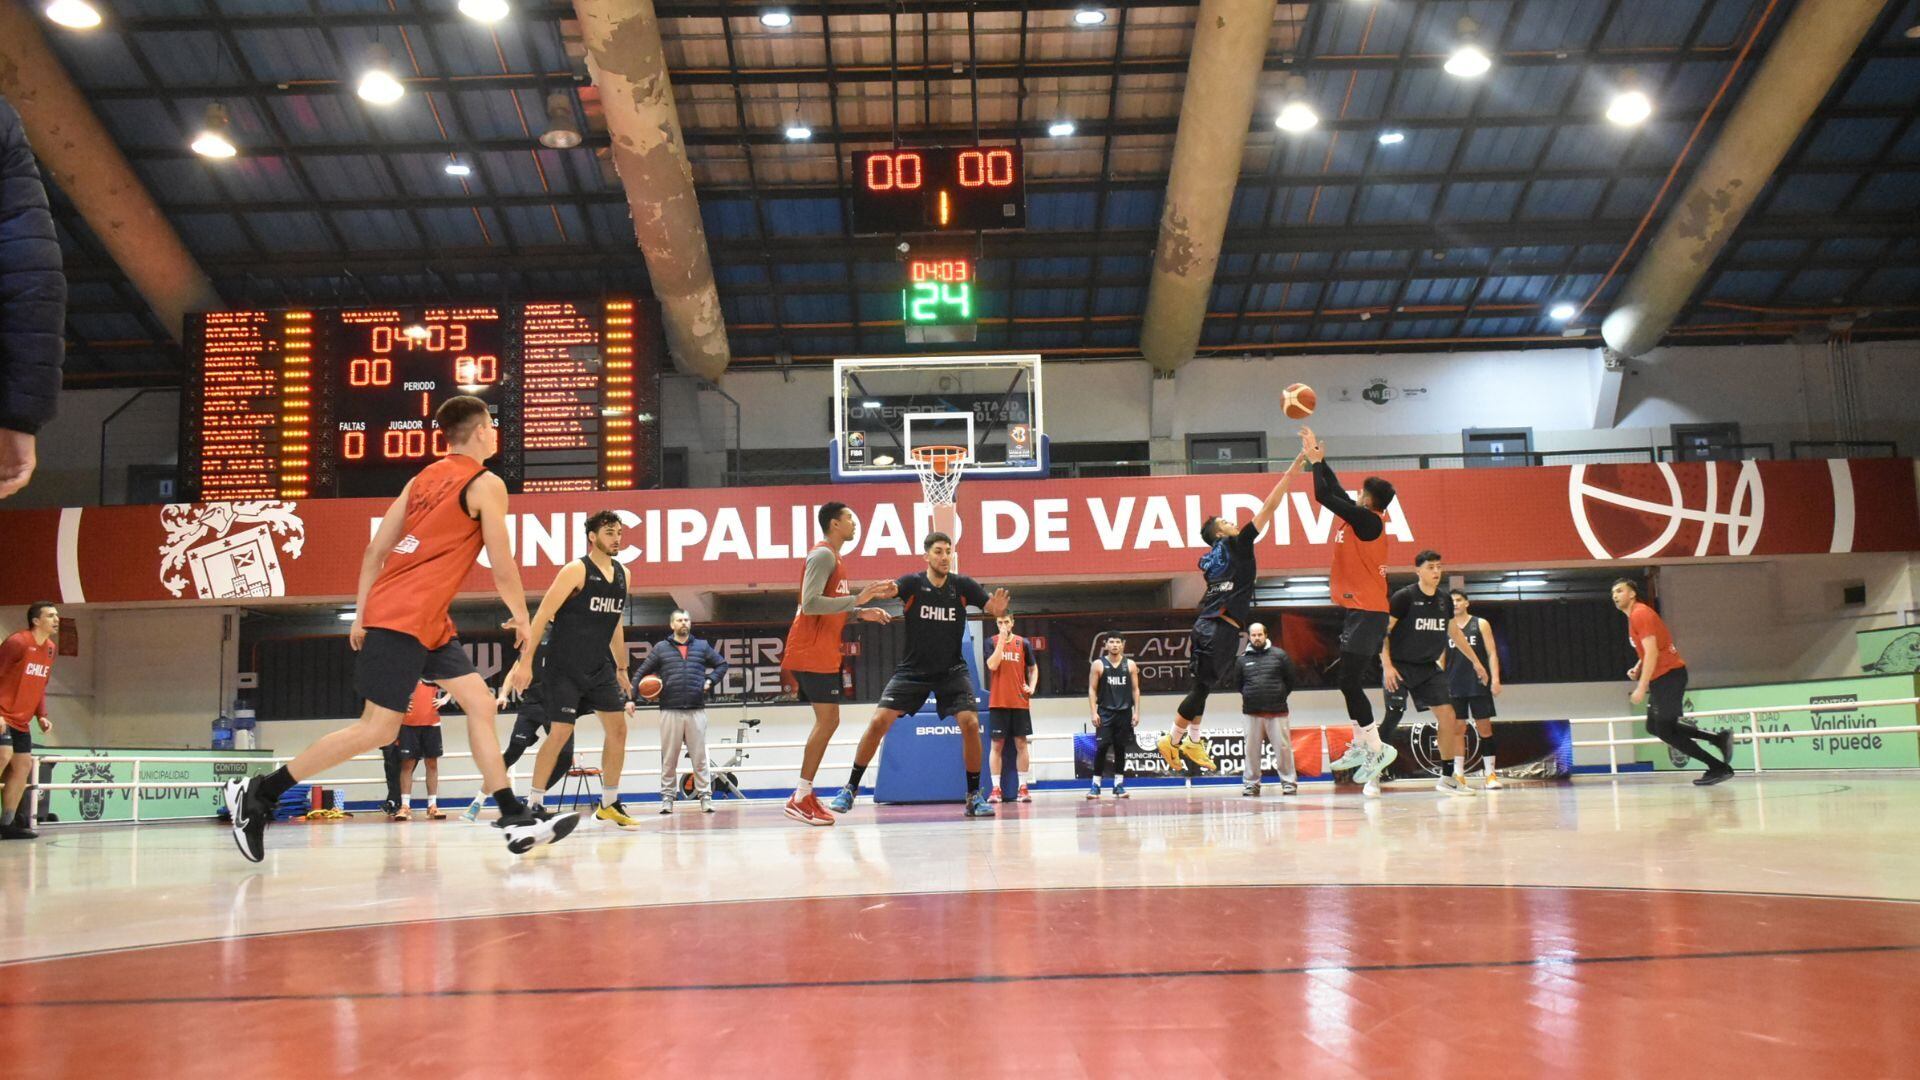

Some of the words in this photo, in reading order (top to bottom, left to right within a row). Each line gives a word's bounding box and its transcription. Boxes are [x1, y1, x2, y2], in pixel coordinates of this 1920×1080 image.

[867, 154, 921, 190] 00
[958, 150, 1012, 187] 00
[912, 261, 967, 282] 04:03
[911, 281, 970, 321] 24
[350, 358, 392, 386] 00
[403, 381, 436, 391] PERIODO
[338, 421, 366, 431] FALTAS
[388, 420, 423, 430] JUGADOR
[344, 432, 365, 459] 0
[384, 430, 425, 458] 00
[981, 499, 1071, 555] DE
[1086, 490, 1415, 551] VALDIVA
[590, 596, 623, 613] CHILE
[920, 605, 956, 621] CHILE
[1415, 618, 1446, 631] CHILE
[1001, 651, 1020, 662] HILE
[26, 662, 50, 678] CHILE
[916, 725, 985, 736] BRONSN
[1811, 713, 1877, 731] Valdivia
[1829, 732, 1883, 755] puede
[215, 763, 247, 772] CONTIGO
[1220, 755, 1278, 774] pude
[137, 770, 190, 780] UNICIPALIDAD
